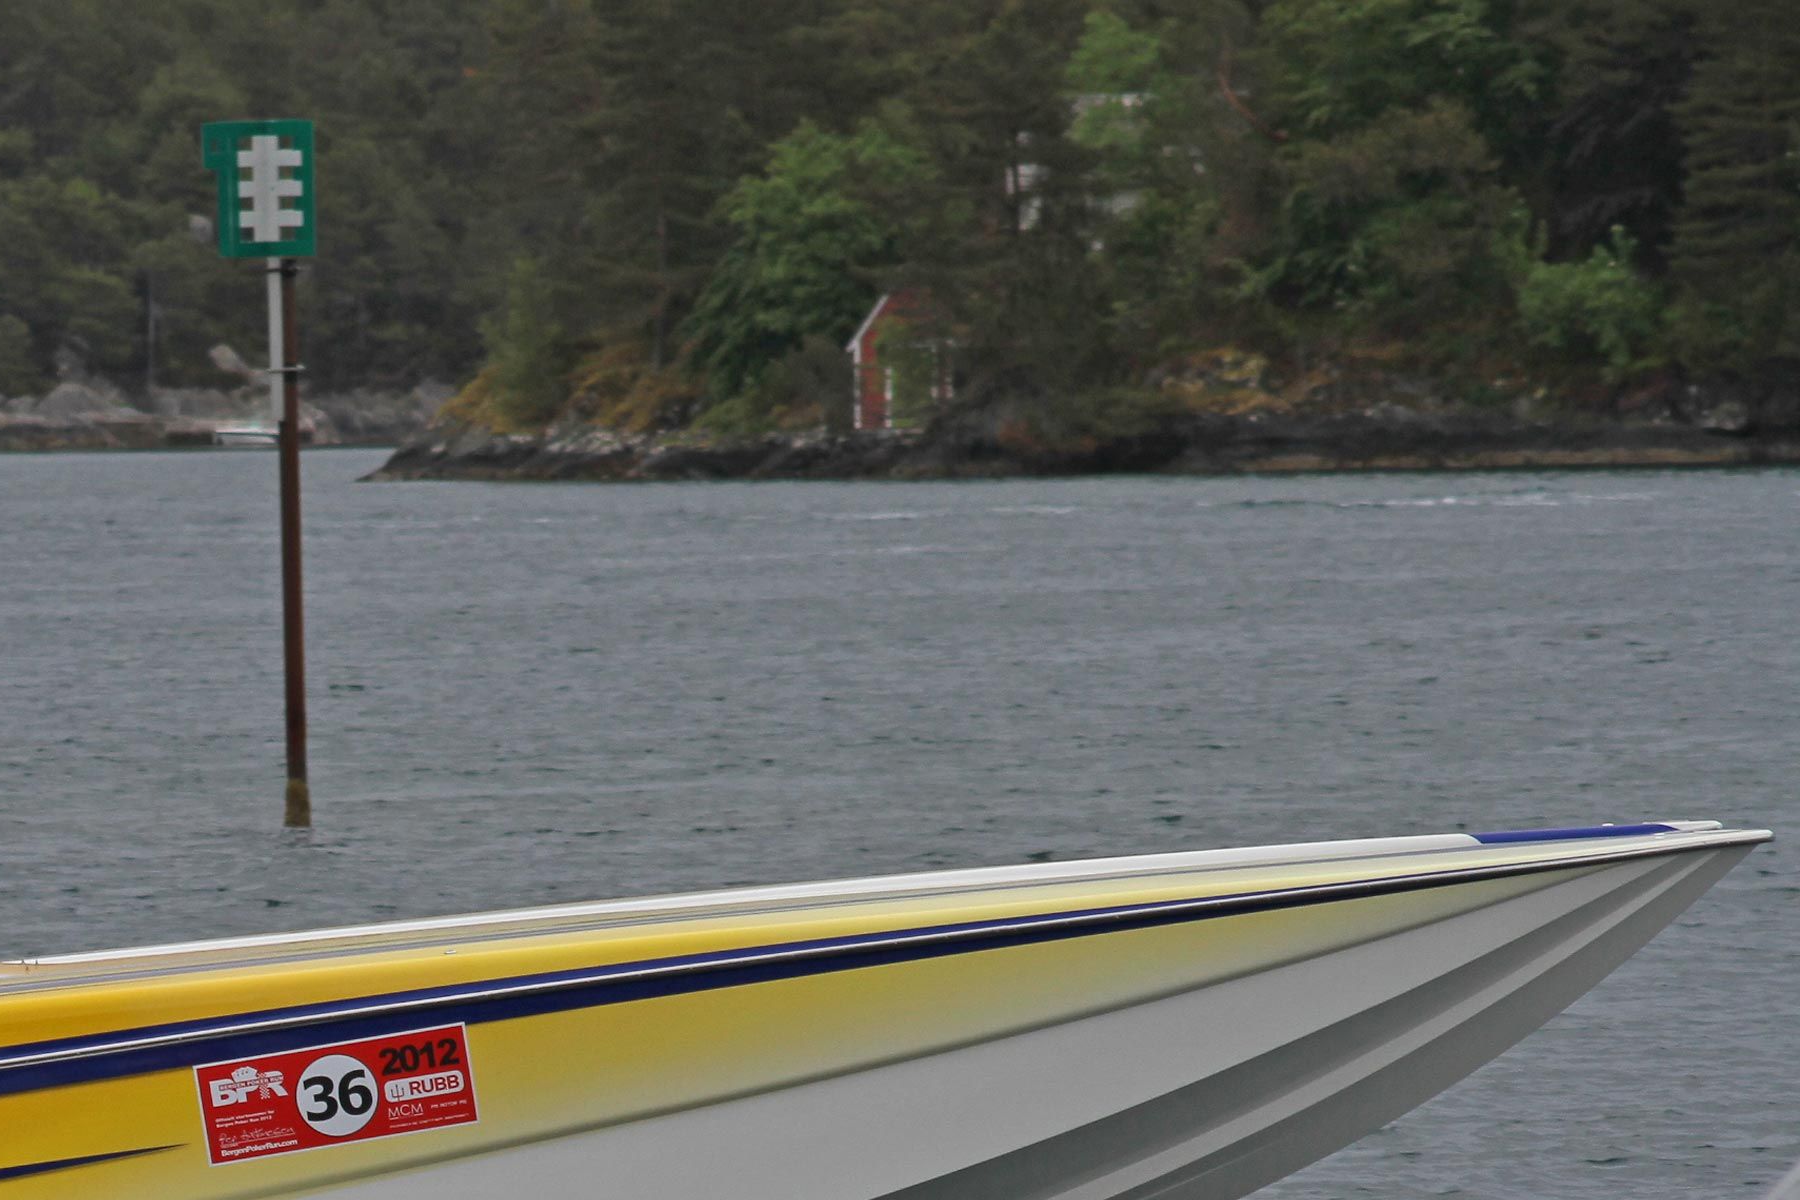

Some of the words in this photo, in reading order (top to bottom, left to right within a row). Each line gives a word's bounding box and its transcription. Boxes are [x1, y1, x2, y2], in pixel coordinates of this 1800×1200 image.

[379, 1038, 460, 1076] 2012
[303, 1069, 373, 1122] 36
[409, 1075, 460, 1095] RUBB
[388, 1103, 423, 1118] MCM
